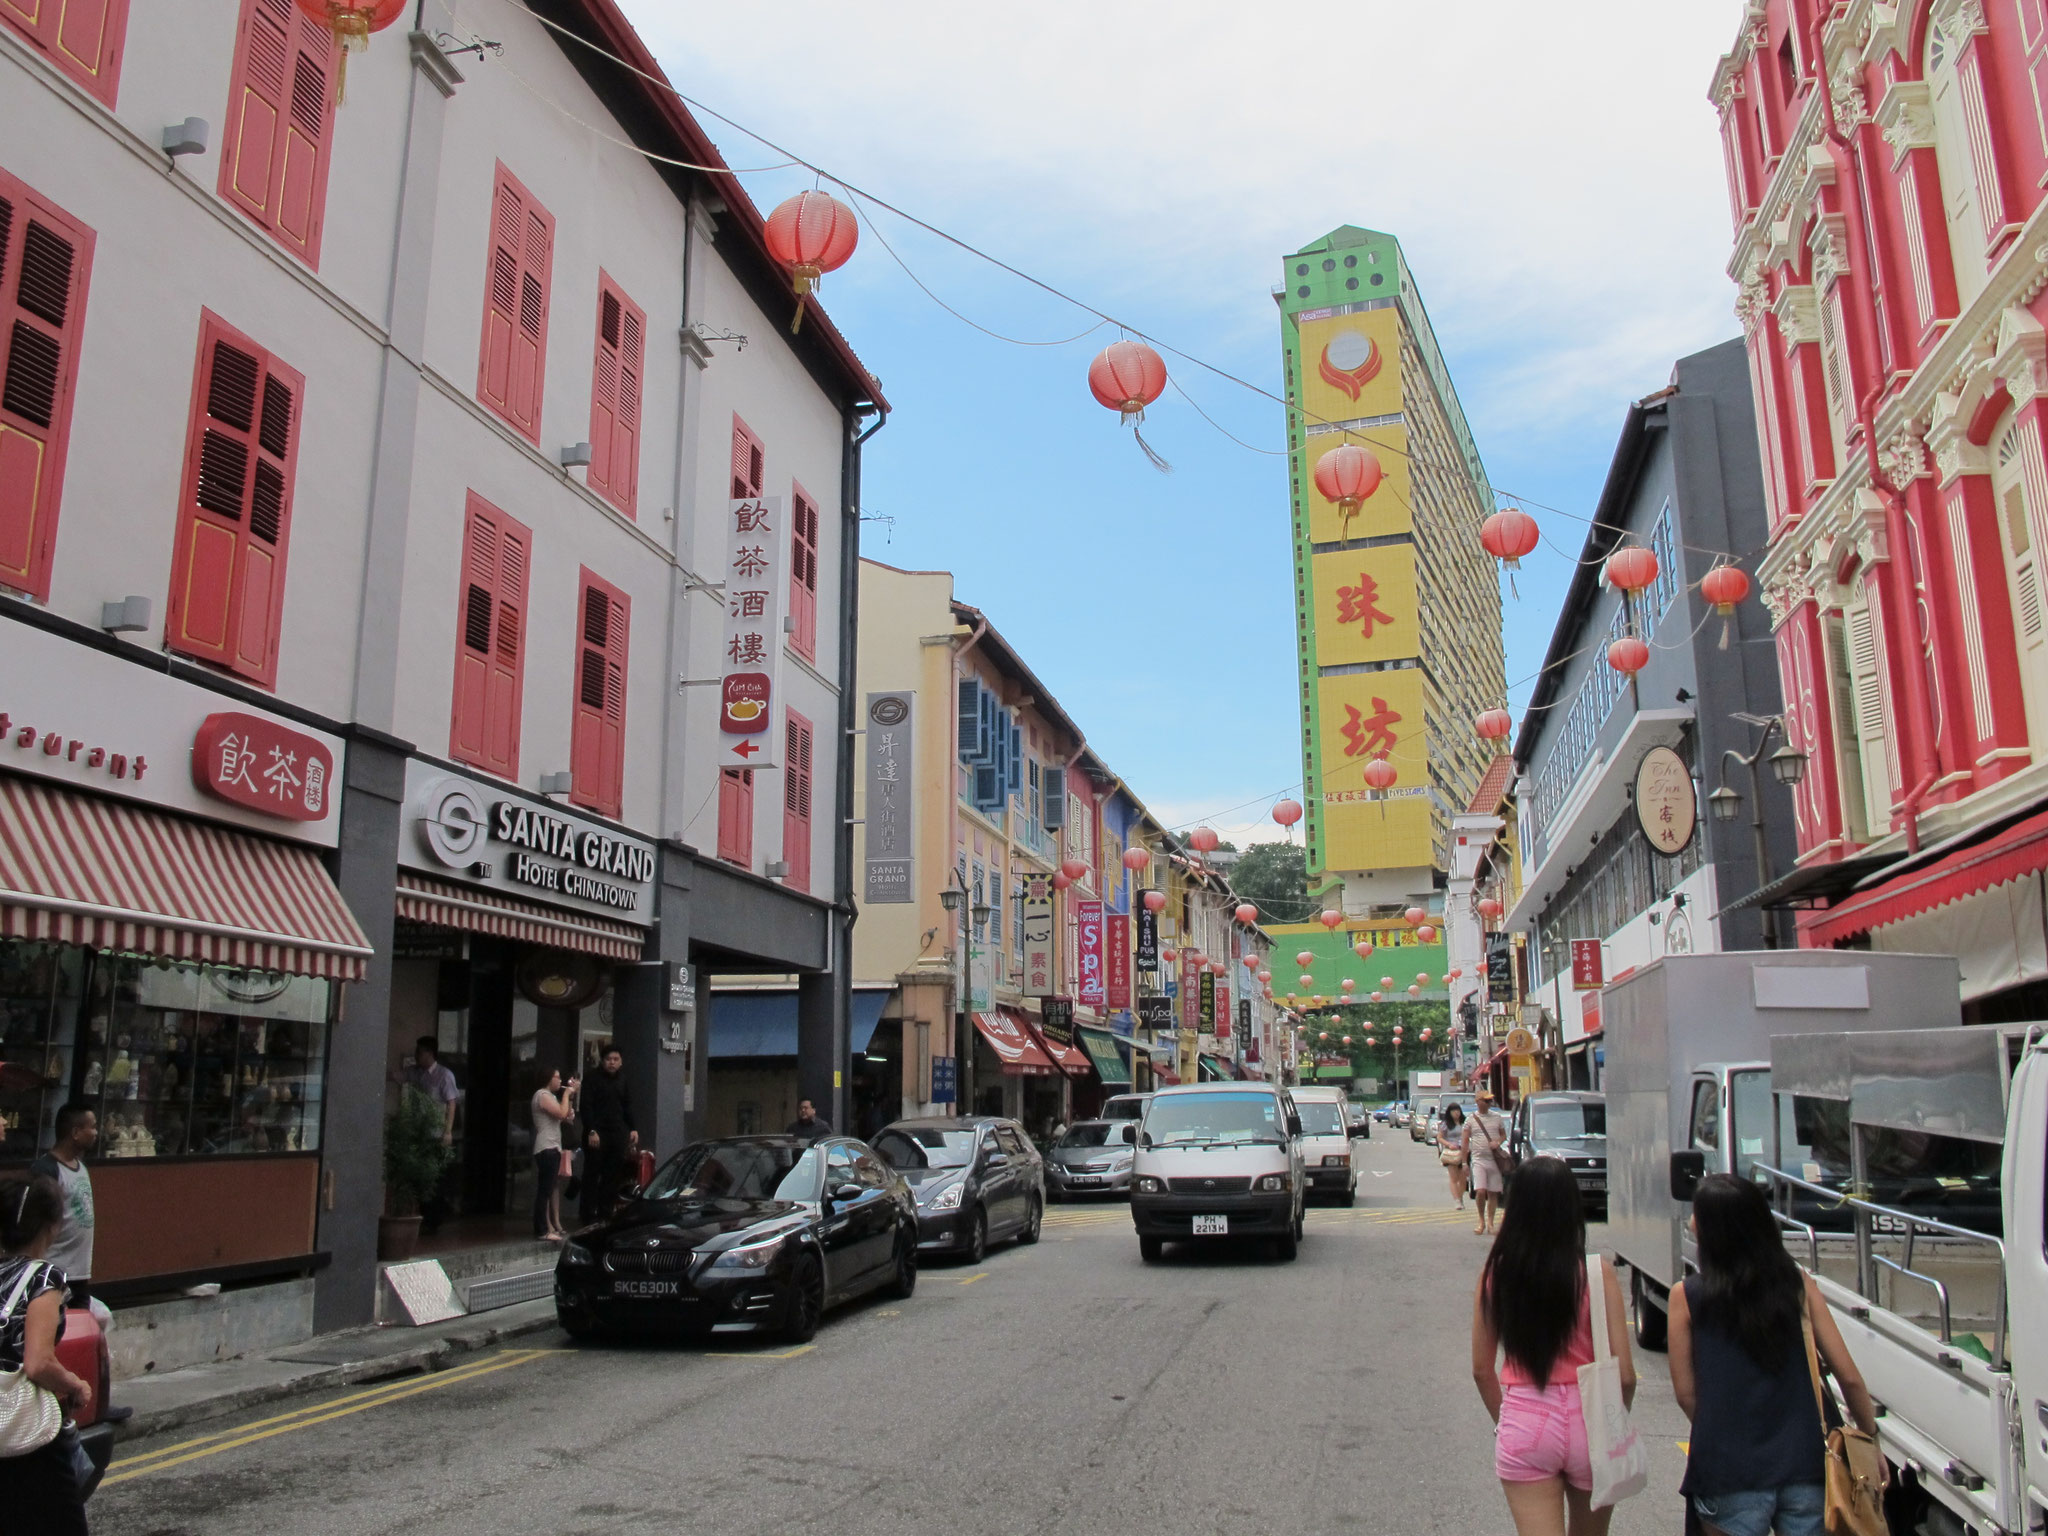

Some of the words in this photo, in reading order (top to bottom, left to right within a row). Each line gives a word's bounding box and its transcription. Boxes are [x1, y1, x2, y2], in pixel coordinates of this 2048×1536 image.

[728, 500, 772, 665] 飲茶酒樓
[218, 731, 301, 801] 飲茶
[1651, 761, 1679, 778] The
[1648, 779, 1680, 795] Inn
[495, 801, 576, 861] SANTA
[582, 831, 655, 884] GRAND
[872, 866, 904, 874] SANTA
[870, 875, 907, 883] GRAND
[1080, 910, 1100, 922] Forever
[1083, 925, 1099, 993] Spa
[1043, 1024, 1072, 1039] ORGANIC
[1204, 1216, 1216, 1224] PH
[1196, 1225, 1224, 1233] 2213H
[614, 1281, 678, 1294] SKC6301X
